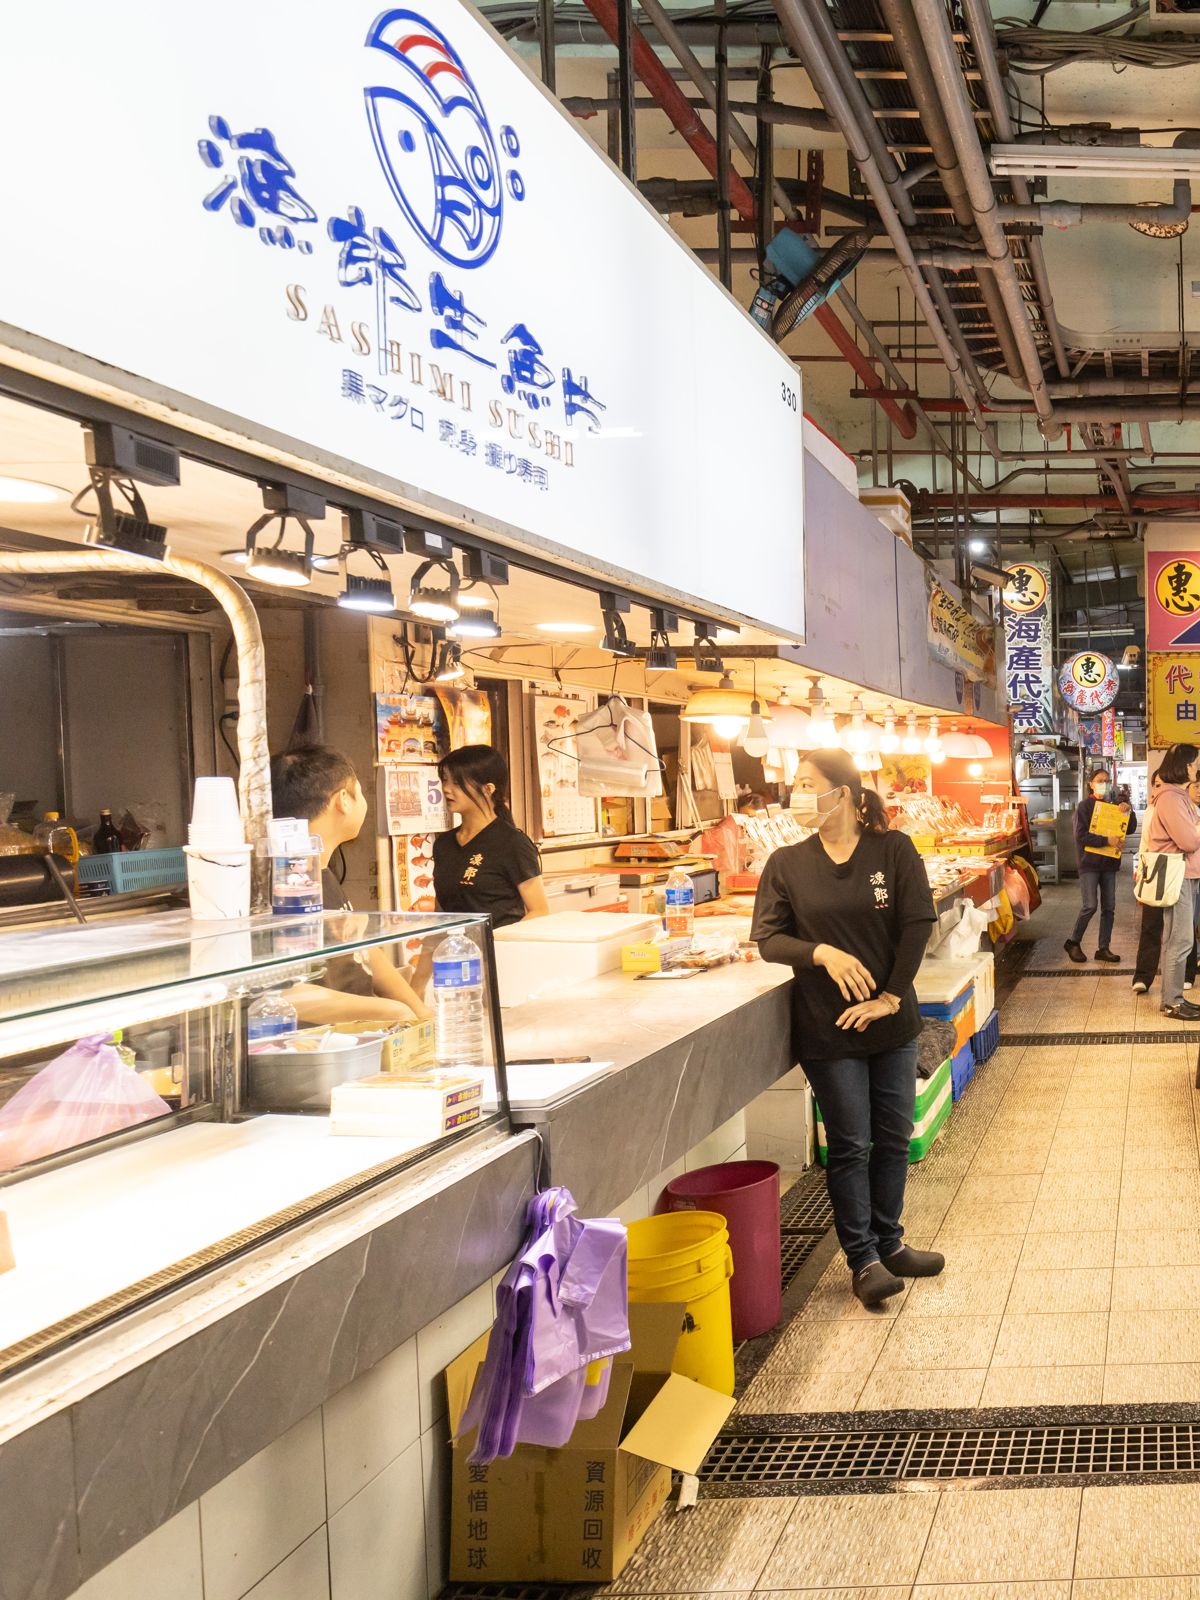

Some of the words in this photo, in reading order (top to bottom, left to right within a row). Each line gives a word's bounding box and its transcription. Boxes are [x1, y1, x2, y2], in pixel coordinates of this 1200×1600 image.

[198, 115, 606, 434] 漁郎生魚片
[286, 284, 473, 413] SASHIMI
[488, 400, 574, 467] SUSHI
[781, 381, 797, 412] 330
[1166, 563, 1200, 612] 惠
[1007, 616, 1044, 727] 海產代煮
[1079, 657, 1101, 684] 惠
[427, 779, 442, 805] 5
[870, 871, 888, 904] 漁郎
[467, 1463, 489, 1570] 愛惜地球
[582, 1460, 606, 1570] 資源回收
